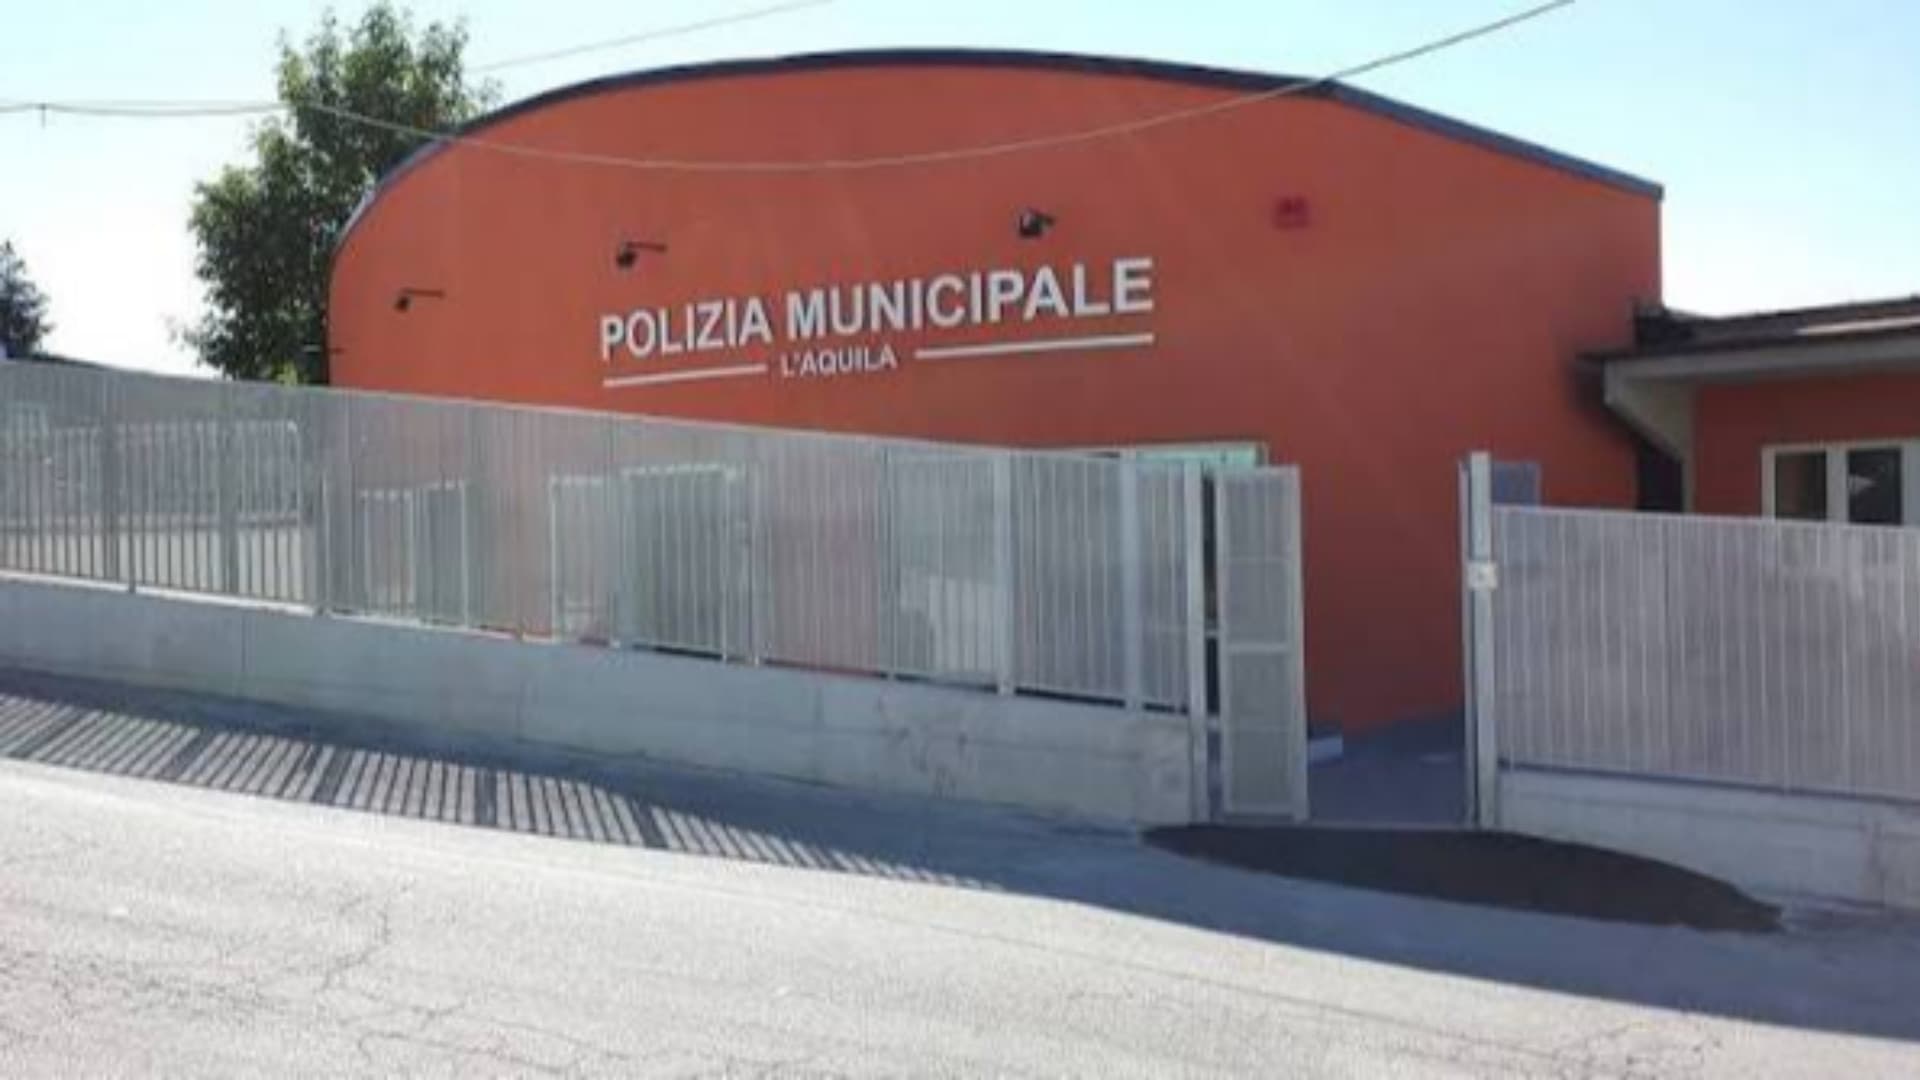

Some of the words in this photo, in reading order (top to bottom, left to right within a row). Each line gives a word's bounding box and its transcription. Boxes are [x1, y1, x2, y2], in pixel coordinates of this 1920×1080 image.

[600, 297, 772, 360] POLIZIA
[786, 257, 1154, 340] MUNICIPALE
[781, 345, 898, 377] L'AQUILA
